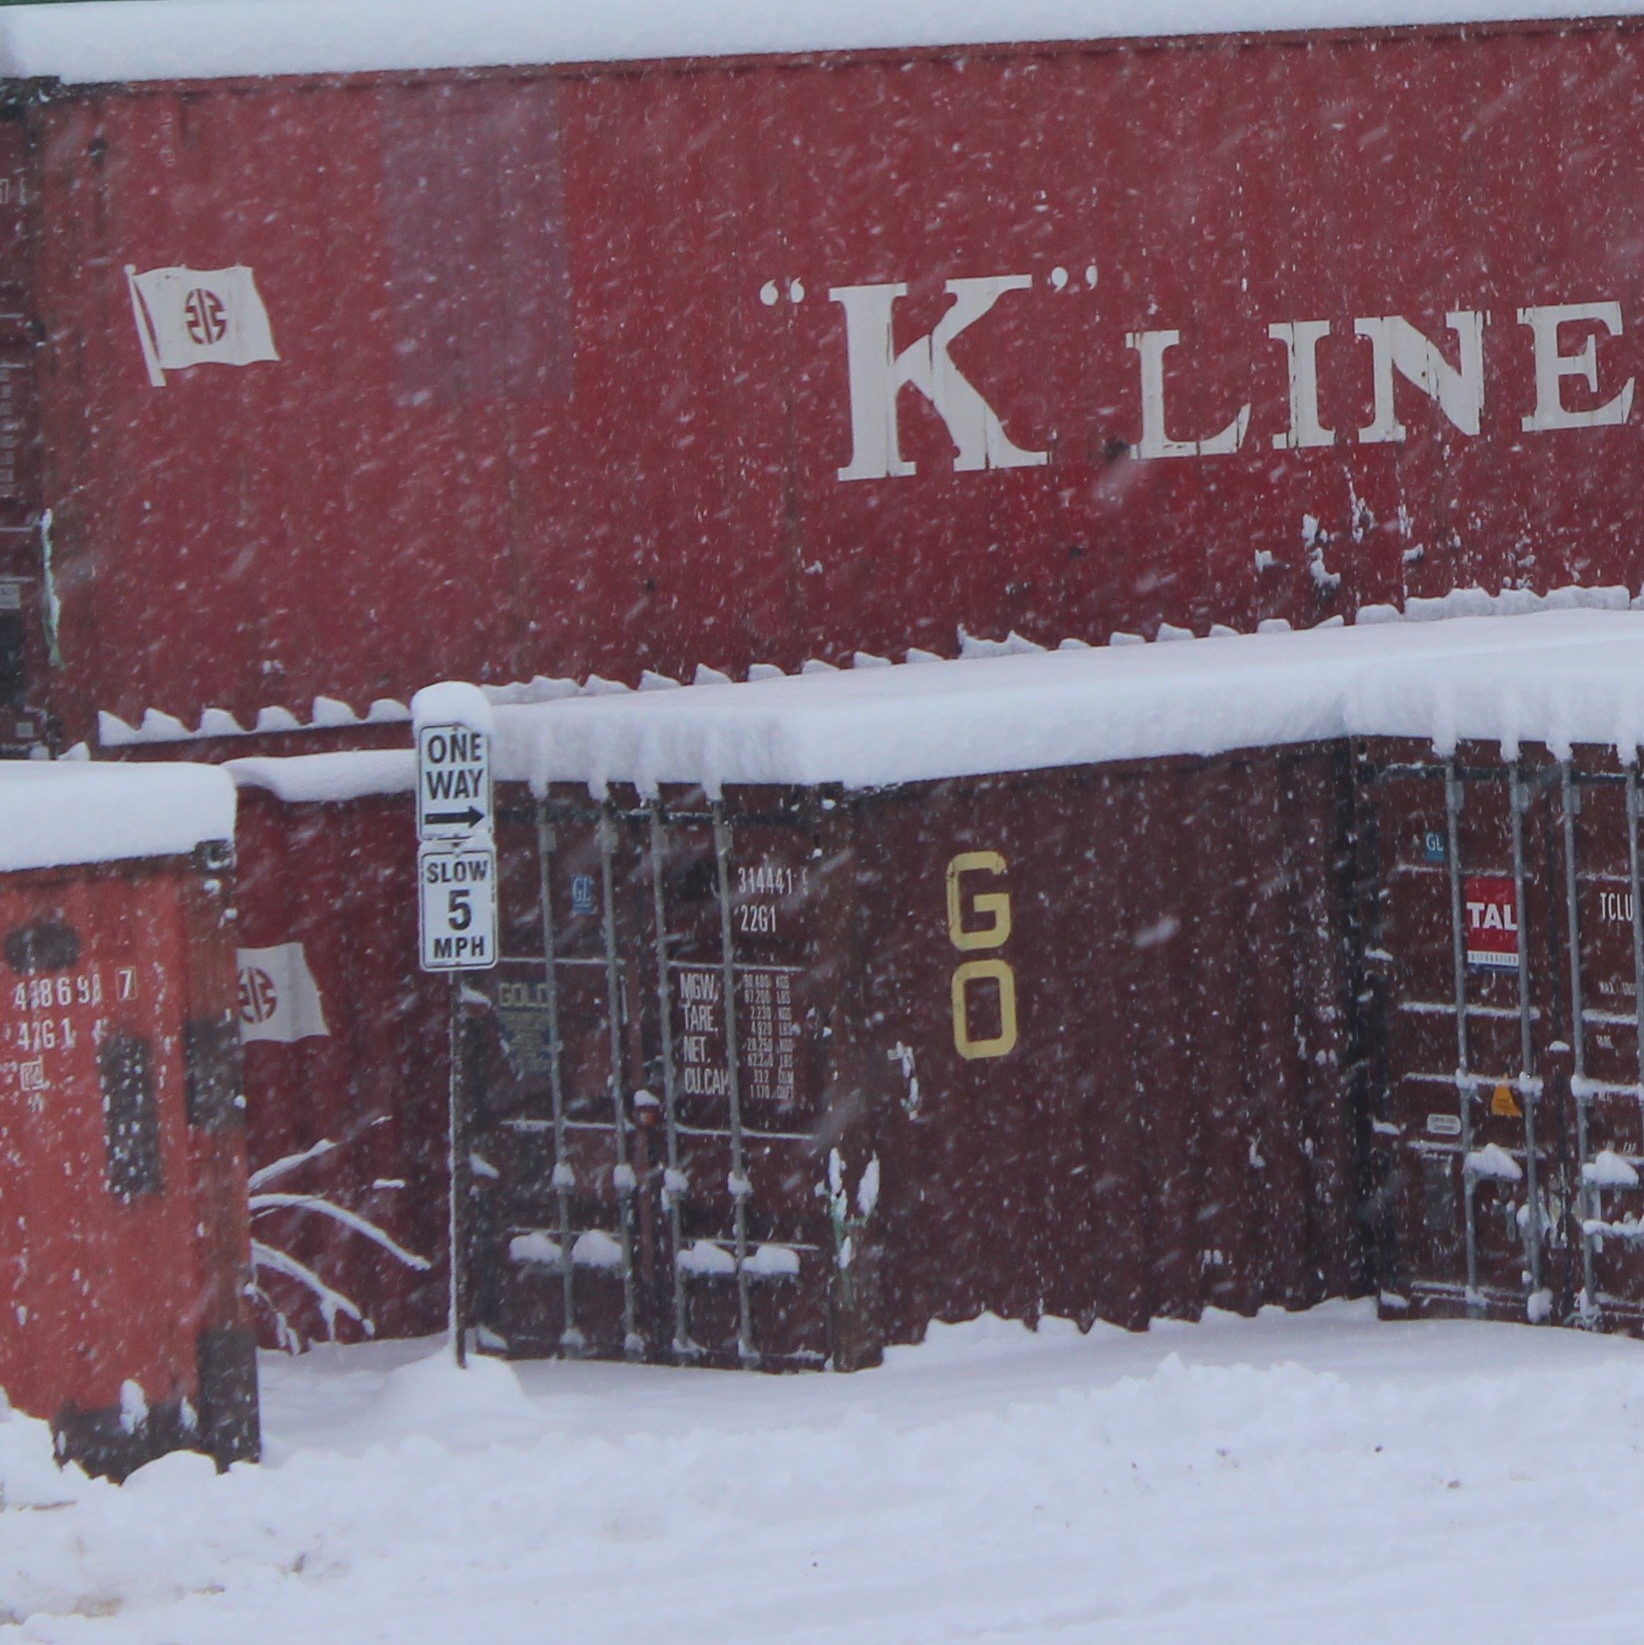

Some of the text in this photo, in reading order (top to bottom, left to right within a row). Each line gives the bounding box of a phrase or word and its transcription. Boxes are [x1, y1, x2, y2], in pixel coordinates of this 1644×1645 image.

[1124, 300, 1637, 460] LINE
[427, 733, 482, 764] ONE
[426, 768, 484, 800] WAY
[426, 860, 489, 884] SLOW
[448, 890, 473, 931] 5
[740, 904, 777, 933] 22G1
[1466, 901, 1519, 931] TAL
[433, 936, 485, 960] MPH
